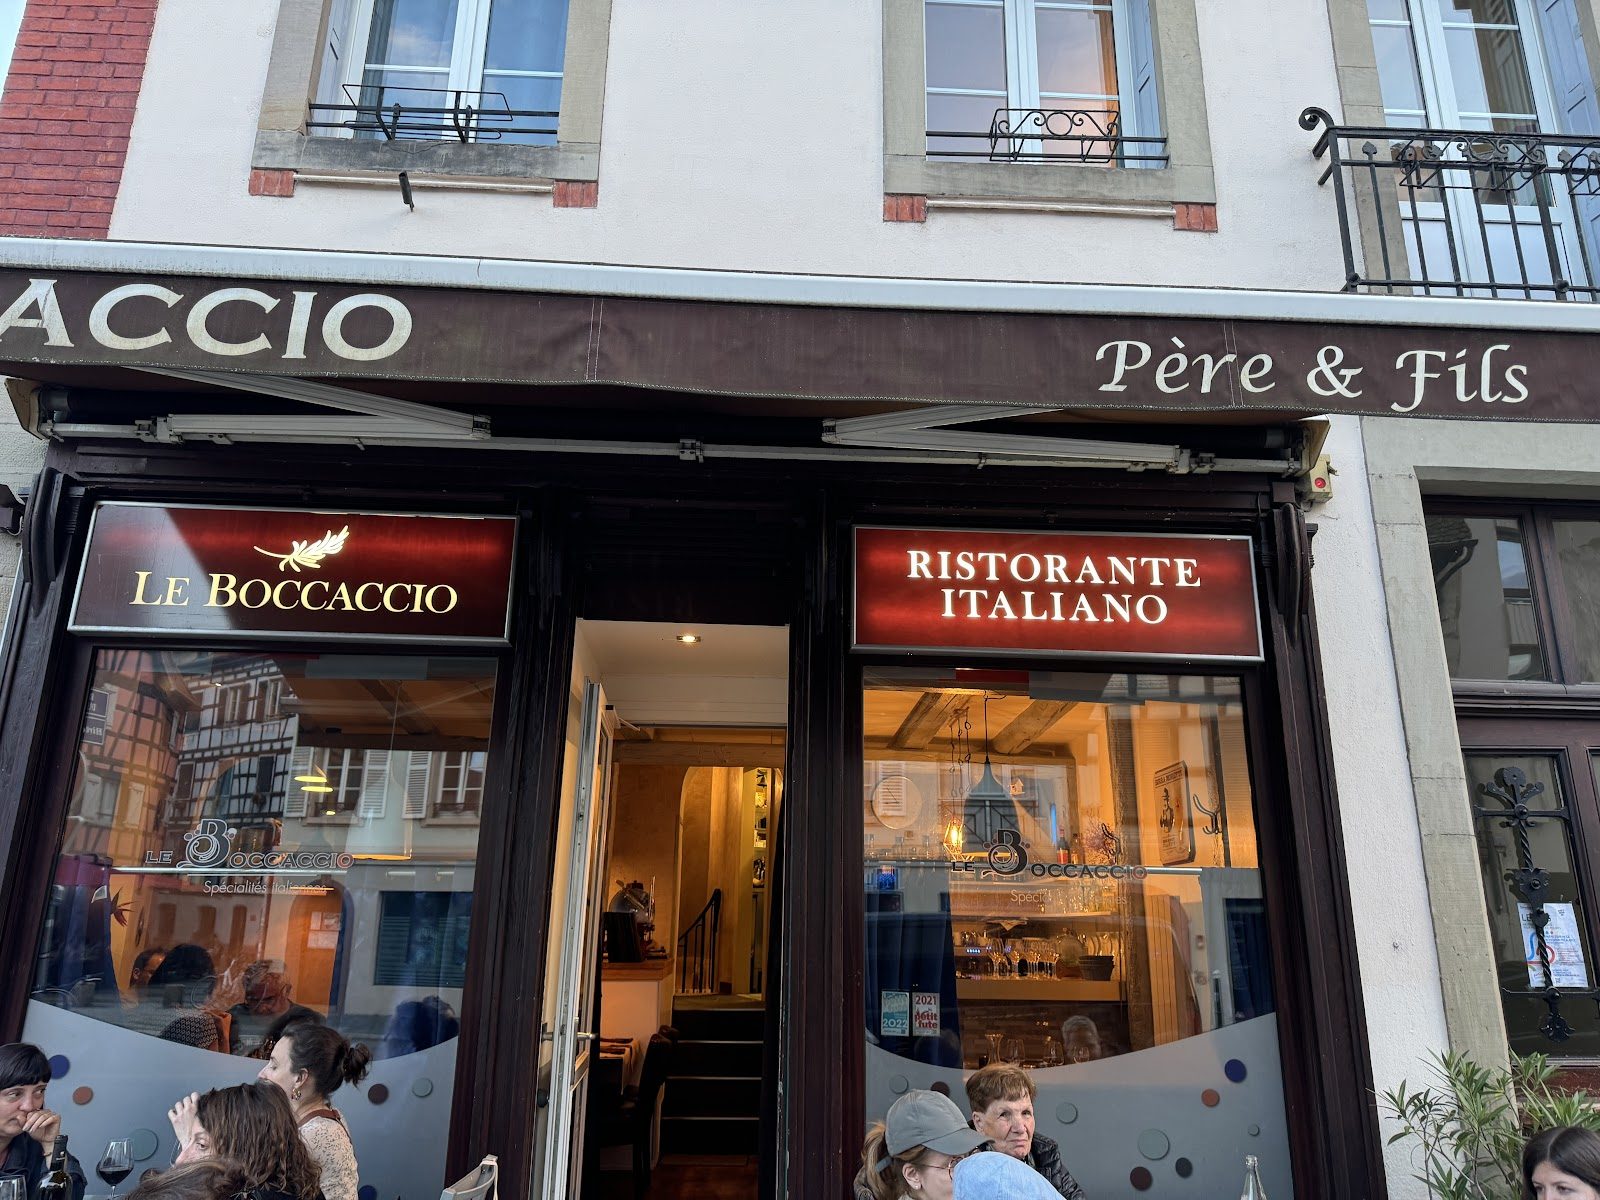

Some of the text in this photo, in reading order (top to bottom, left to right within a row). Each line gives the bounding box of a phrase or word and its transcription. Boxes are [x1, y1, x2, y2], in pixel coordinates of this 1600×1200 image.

[0, 278, 413, 362] ACCIO
[1095, 336, 1530, 414] Père & Fils
[905, 549, 1202, 589] RISTORANTE
[203, 572, 459, 614] BOCCACCIO
[940, 587, 1170, 625] ITALIANO
[145, 850, 174, 864] LE
[951, 860, 976, 874] LE
[203, 880, 267, 897] Spécialités
[915, 995, 937, 1006] 2021
[883, 1018, 908, 1029] 2022
